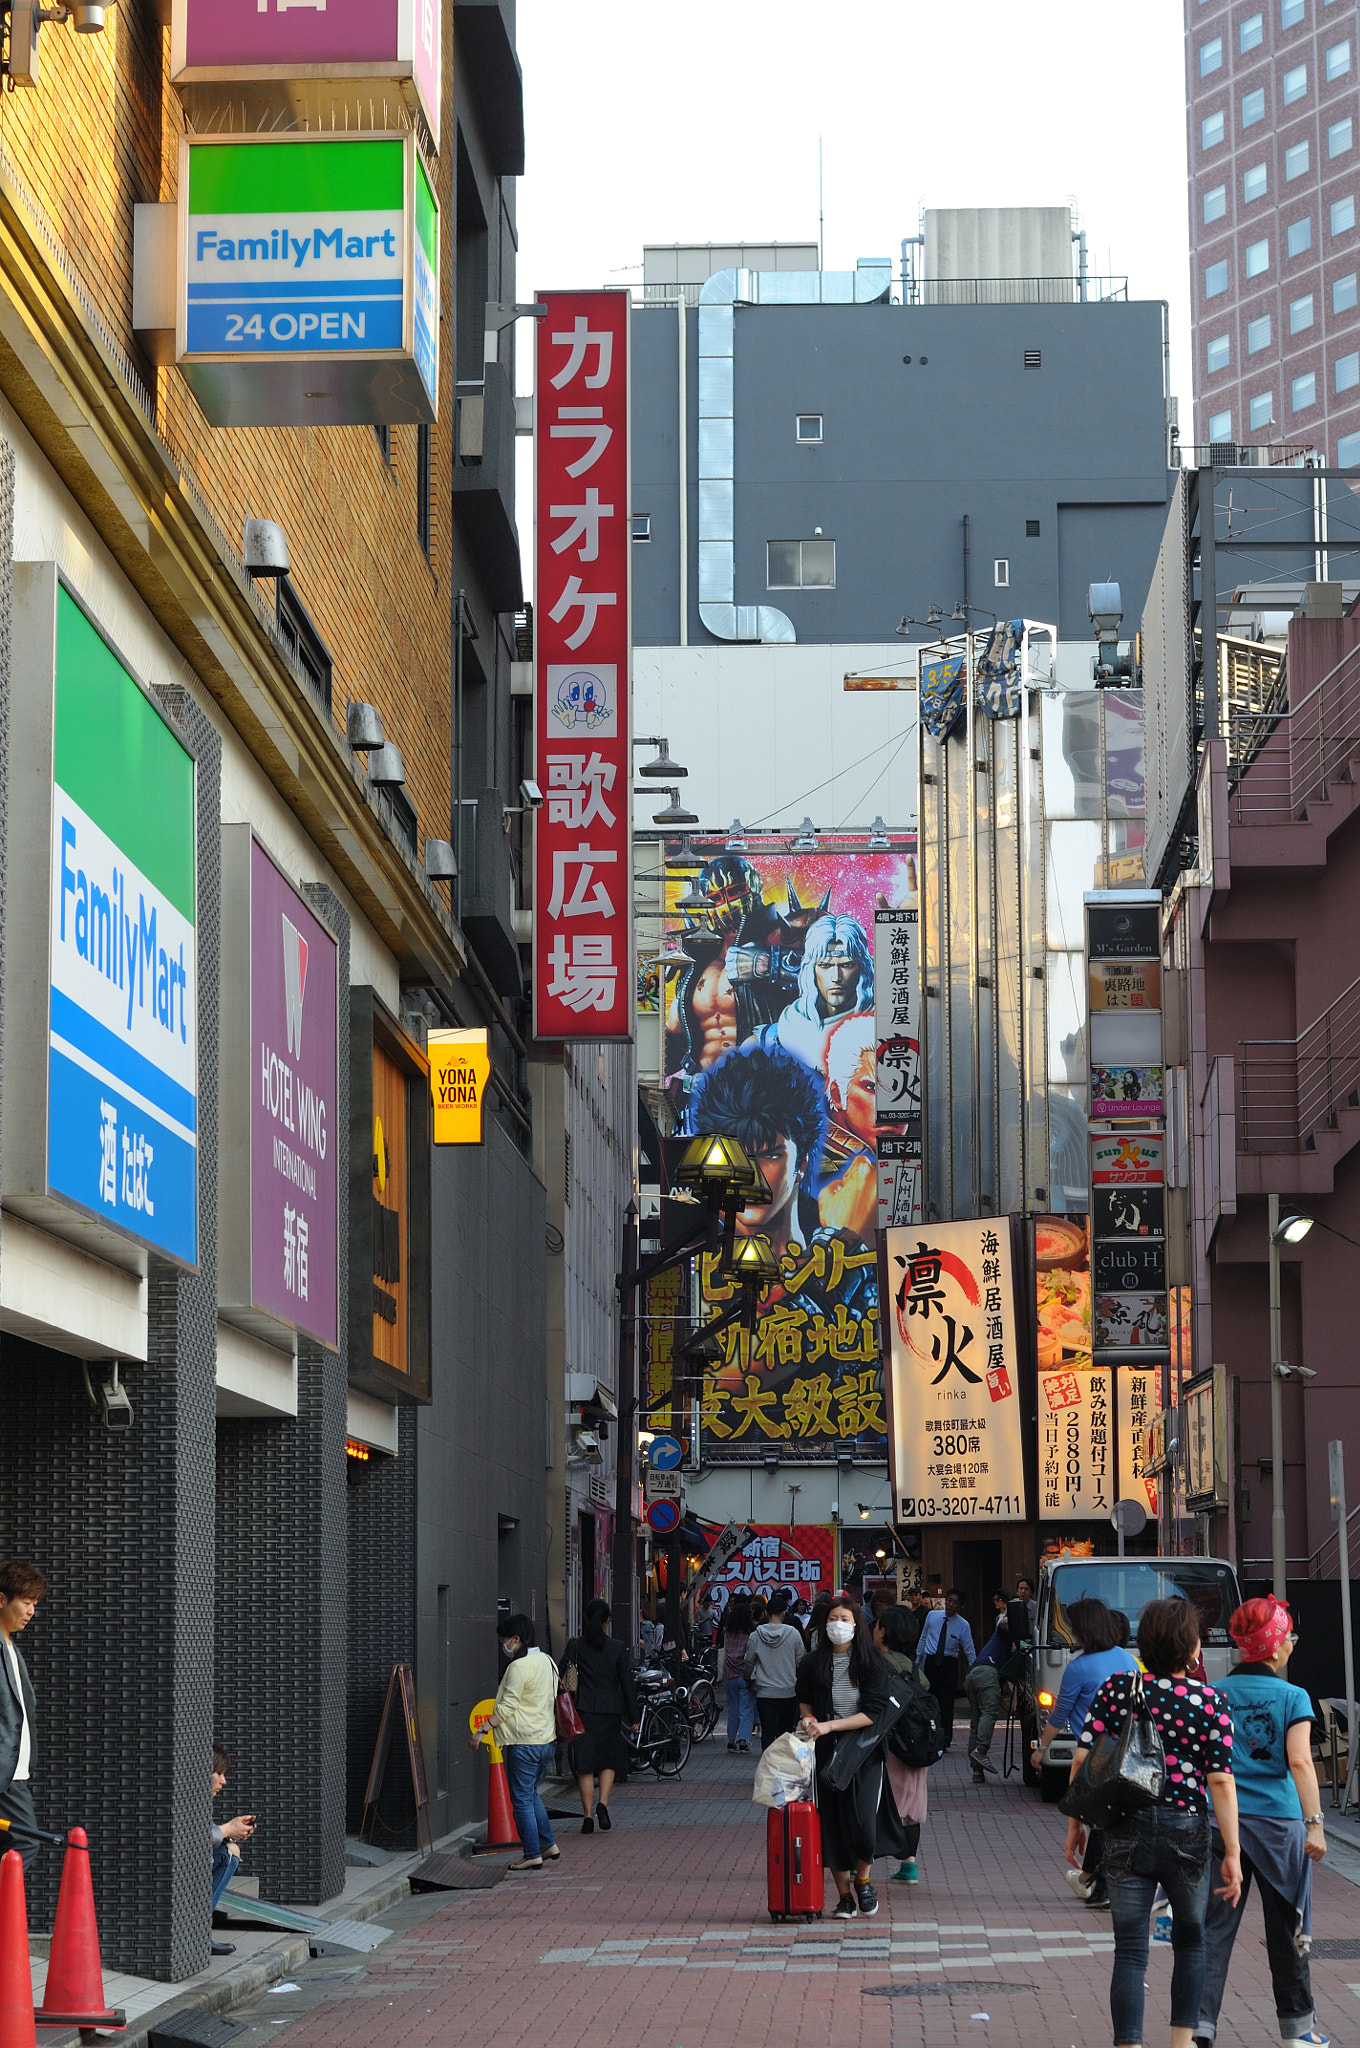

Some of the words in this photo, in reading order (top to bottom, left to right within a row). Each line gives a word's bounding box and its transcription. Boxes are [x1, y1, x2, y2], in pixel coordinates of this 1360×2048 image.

[196, 227, 396, 268] FamilyMart
[548, 316, 618, 651] カラオケ
[546, 751, 618, 1014] 歌広場
[60, 815, 187, 1045] FamilyMart
[1096, 943, 1114, 952] M's
[1116, 943, 1152, 952] Garden
[890, 927, 911, 1025] 海鮮居酒屋
[1104, 978, 1145, 991] 裏路地
[439, 1069, 477, 1084] YONA
[262, 1042, 295, 1133] HOTEL
[297, 1077, 327, 1160] WING
[439, 1087, 477, 1102] YONA
[99, 1098, 118, 1208] 酒
[121, 1126, 154, 1216] たばこ
[273, 1135, 317, 1201] INTERNATIONAL
[1109, 1171, 1147, 1182] サンクス
[284, 1201, 308, 1301] 新宿
[1101, 1252, 1138, 1267] club
[1143, 1252, 1158, 1267] H
[980, 1229, 1006, 1369] 海鮮居酒屋
[936, 1389, 967, 1400] rinka
[986, 1372, 1012, 1398] 旨い
[925, 1419, 987, 1432] 歌舞伎町最大級
[933, 1434, 981, 1457] 380席
[1090, 1376, 1107, 1510] 飲み放題付コース
[927, 1462, 989, 1476] 大宴会場120席
[1044, 1412, 1060, 1508] 当日予約可能
[649, 1480, 678, 1488] 一方通行
[940, 1477, 976, 1489] 完全個室
[918, 1496, 1021, 1517] 03-3207-4711
[742, 1537, 781, 1557] 新宿
